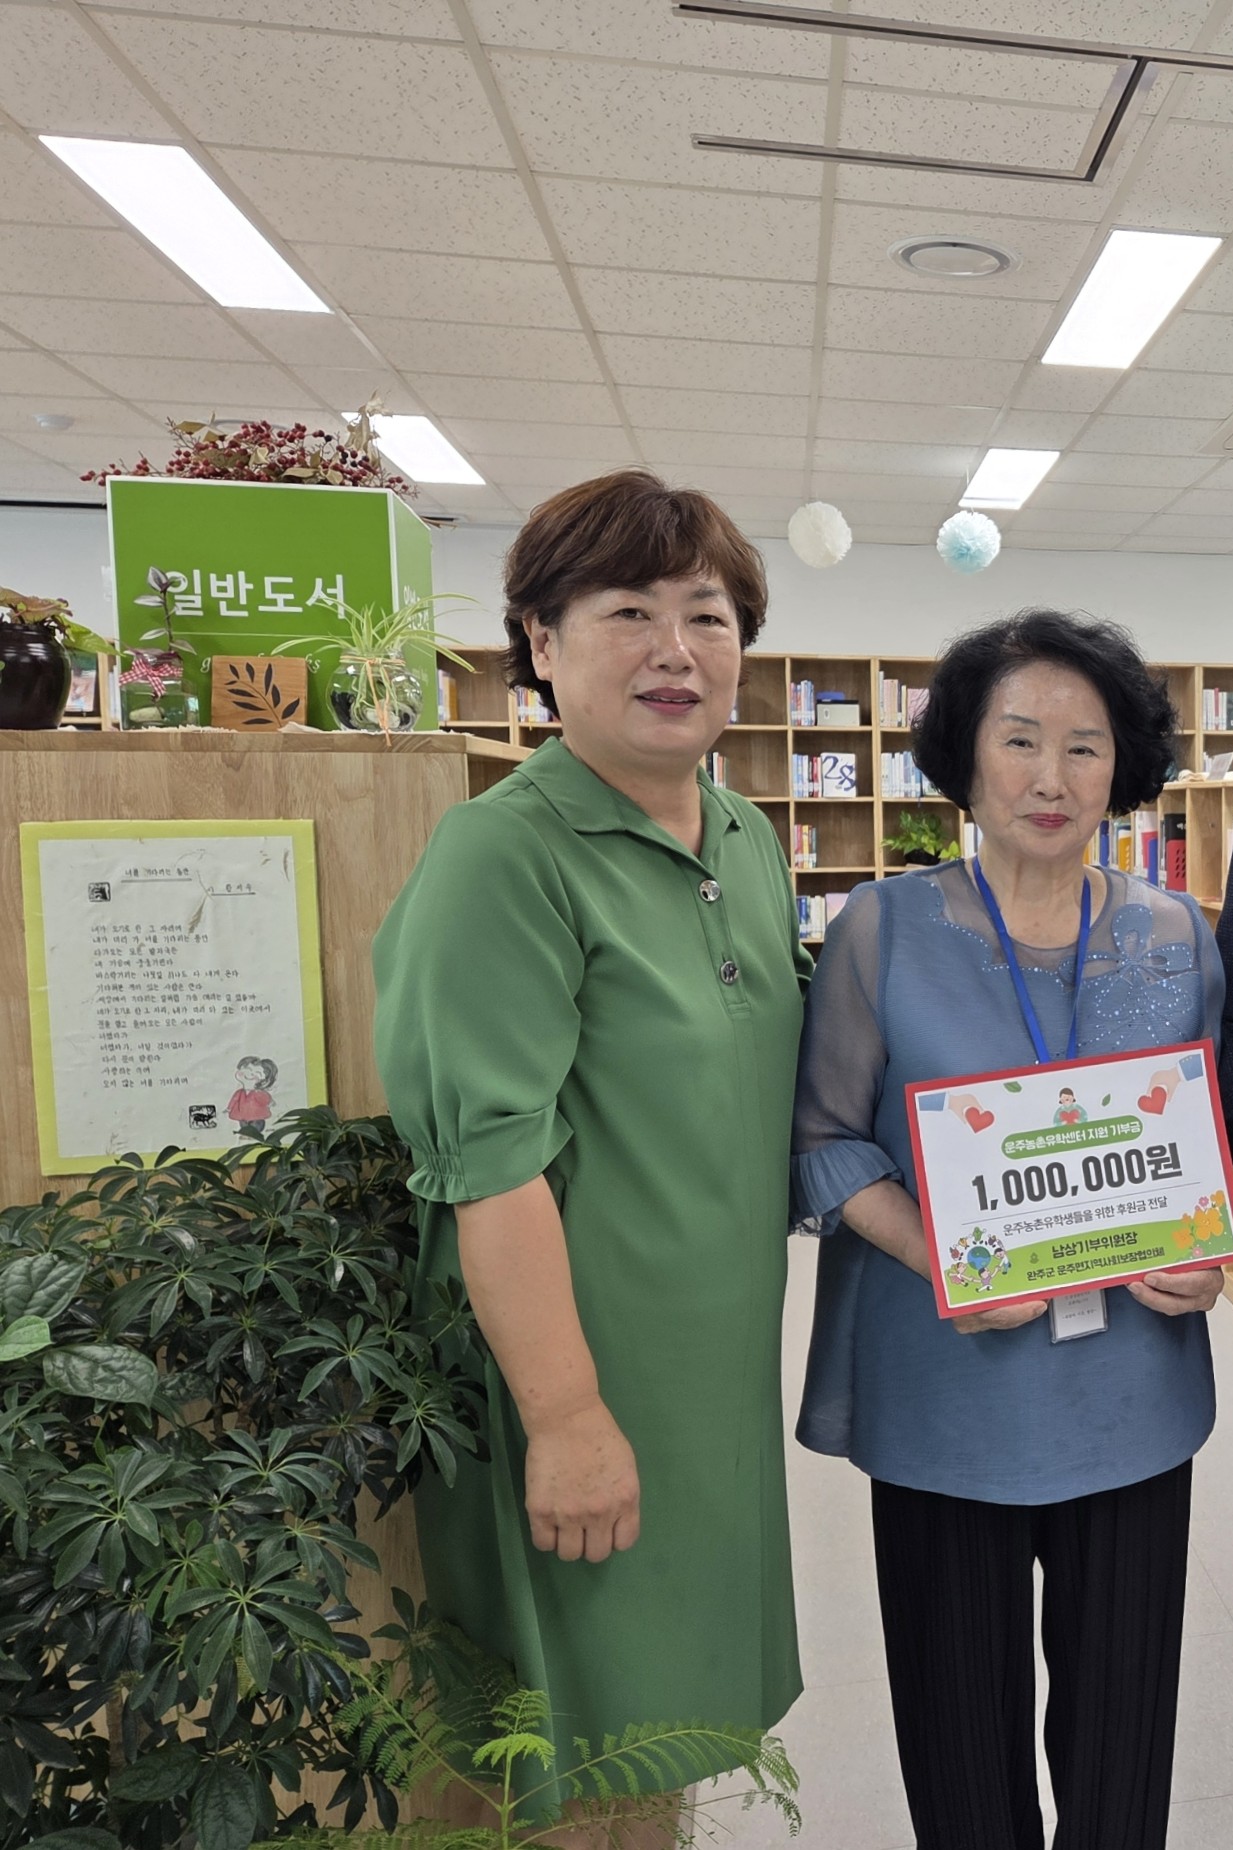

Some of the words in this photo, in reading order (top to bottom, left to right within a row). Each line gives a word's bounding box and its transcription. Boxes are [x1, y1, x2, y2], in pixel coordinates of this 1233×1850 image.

[165, 569, 345, 619] 일반도서
[1005, 1130, 1085, 1153] 운주농촌유학센터
[1088, 1126, 1109, 1140] 지원
[1110, 1122, 1140, 1136] 기부금
[972, 1142, 1182, 1211] 1,000,000원
[1003, 1209, 1093, 1236] 운주농촌유학생들을
[1095, 1206, 1115, 1219] 위한
[1117, 1201, 1146, 1215] 후원금
[1148, 1196, 1168, 1209] 전달
[1027, 1266, 1055, 1281] 완주군
[1057, 1247, 1165, 1276] 운주면지역사회보장협의체
[1052, 1232, 1138, 1259] 남상기부위원장
